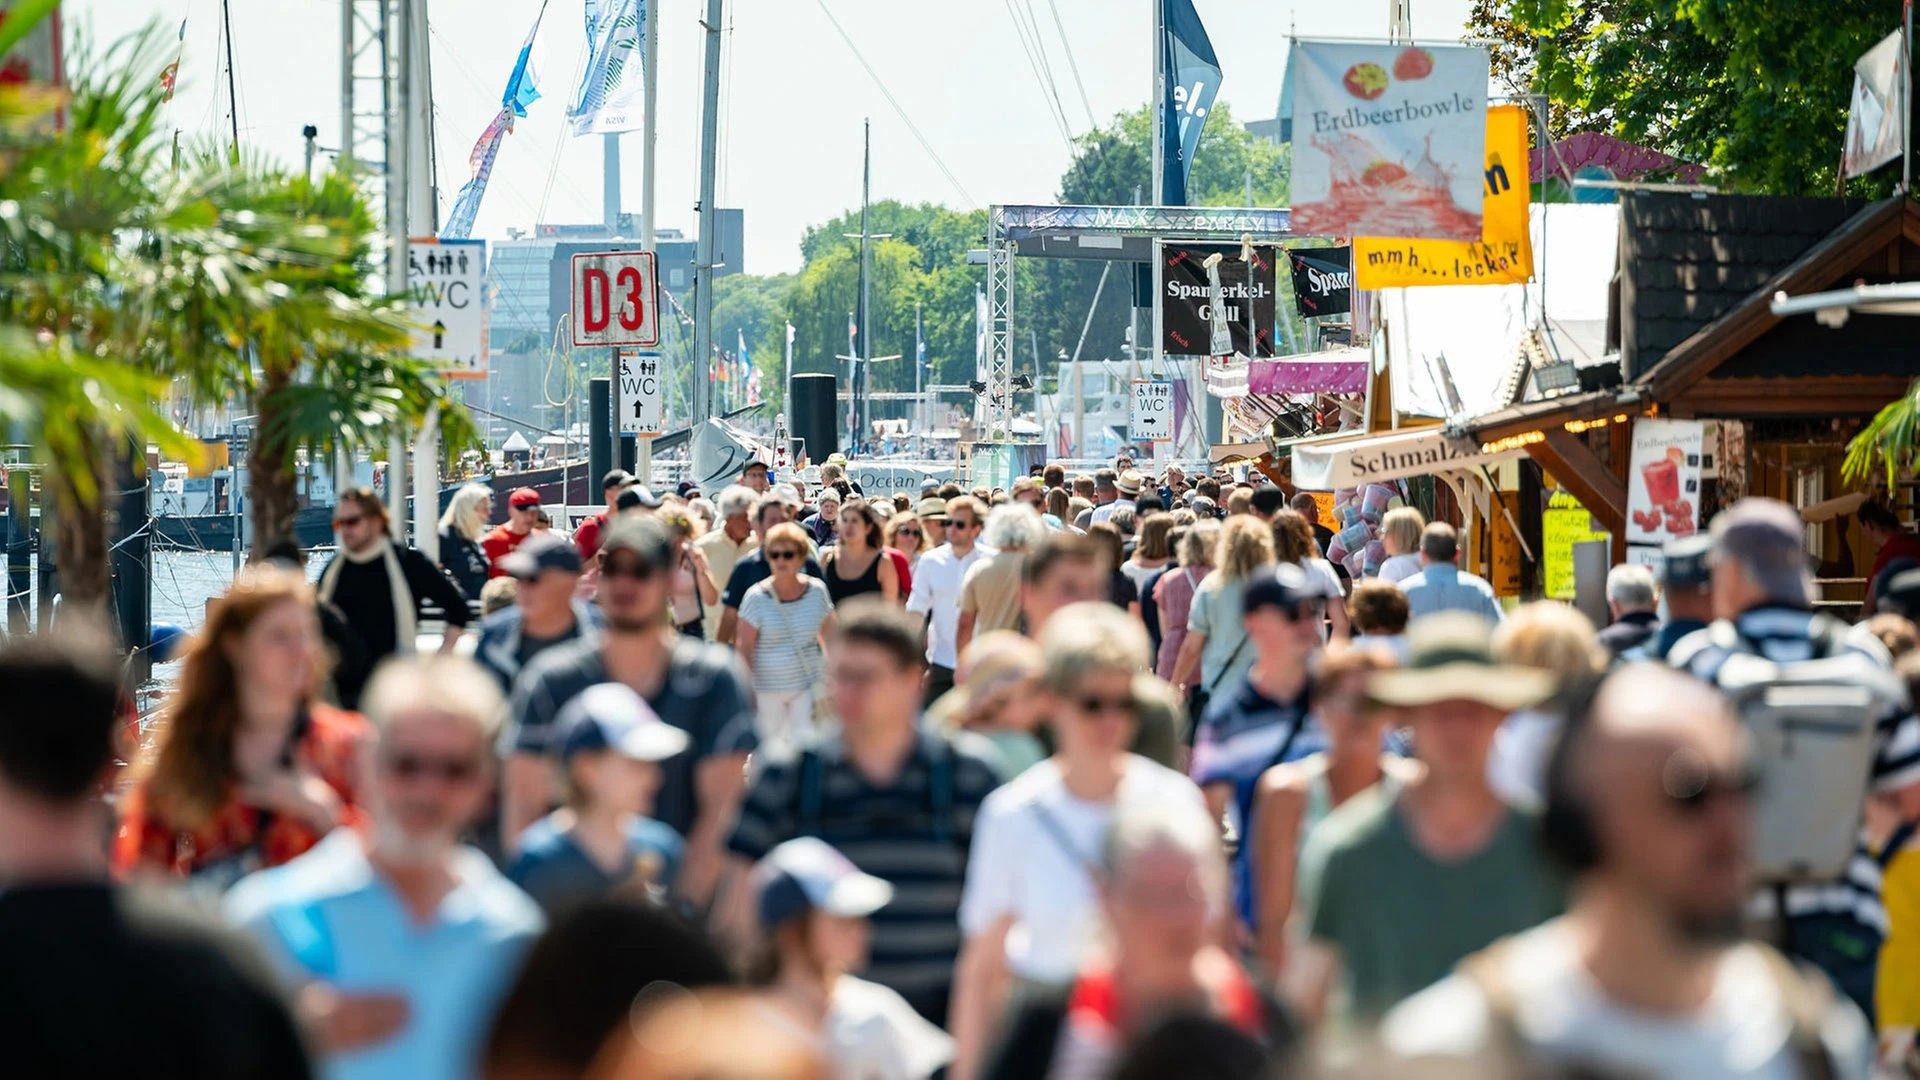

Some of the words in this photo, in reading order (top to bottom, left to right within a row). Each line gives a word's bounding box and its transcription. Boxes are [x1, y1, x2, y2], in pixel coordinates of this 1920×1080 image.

[1313, 92, 1475, 133] Erdbeerbowle
[1167, 280, 1271, 300] Spanerkel-
[1307, 267, 1351, 296] Span
[411, 281, 469, 309] WC
[583, 266, 643, 332] D3
[622, 378, 656, 395] WC
[1139, 398, 1165, 412] WC
[860, 473, 915, 489] Ocean
